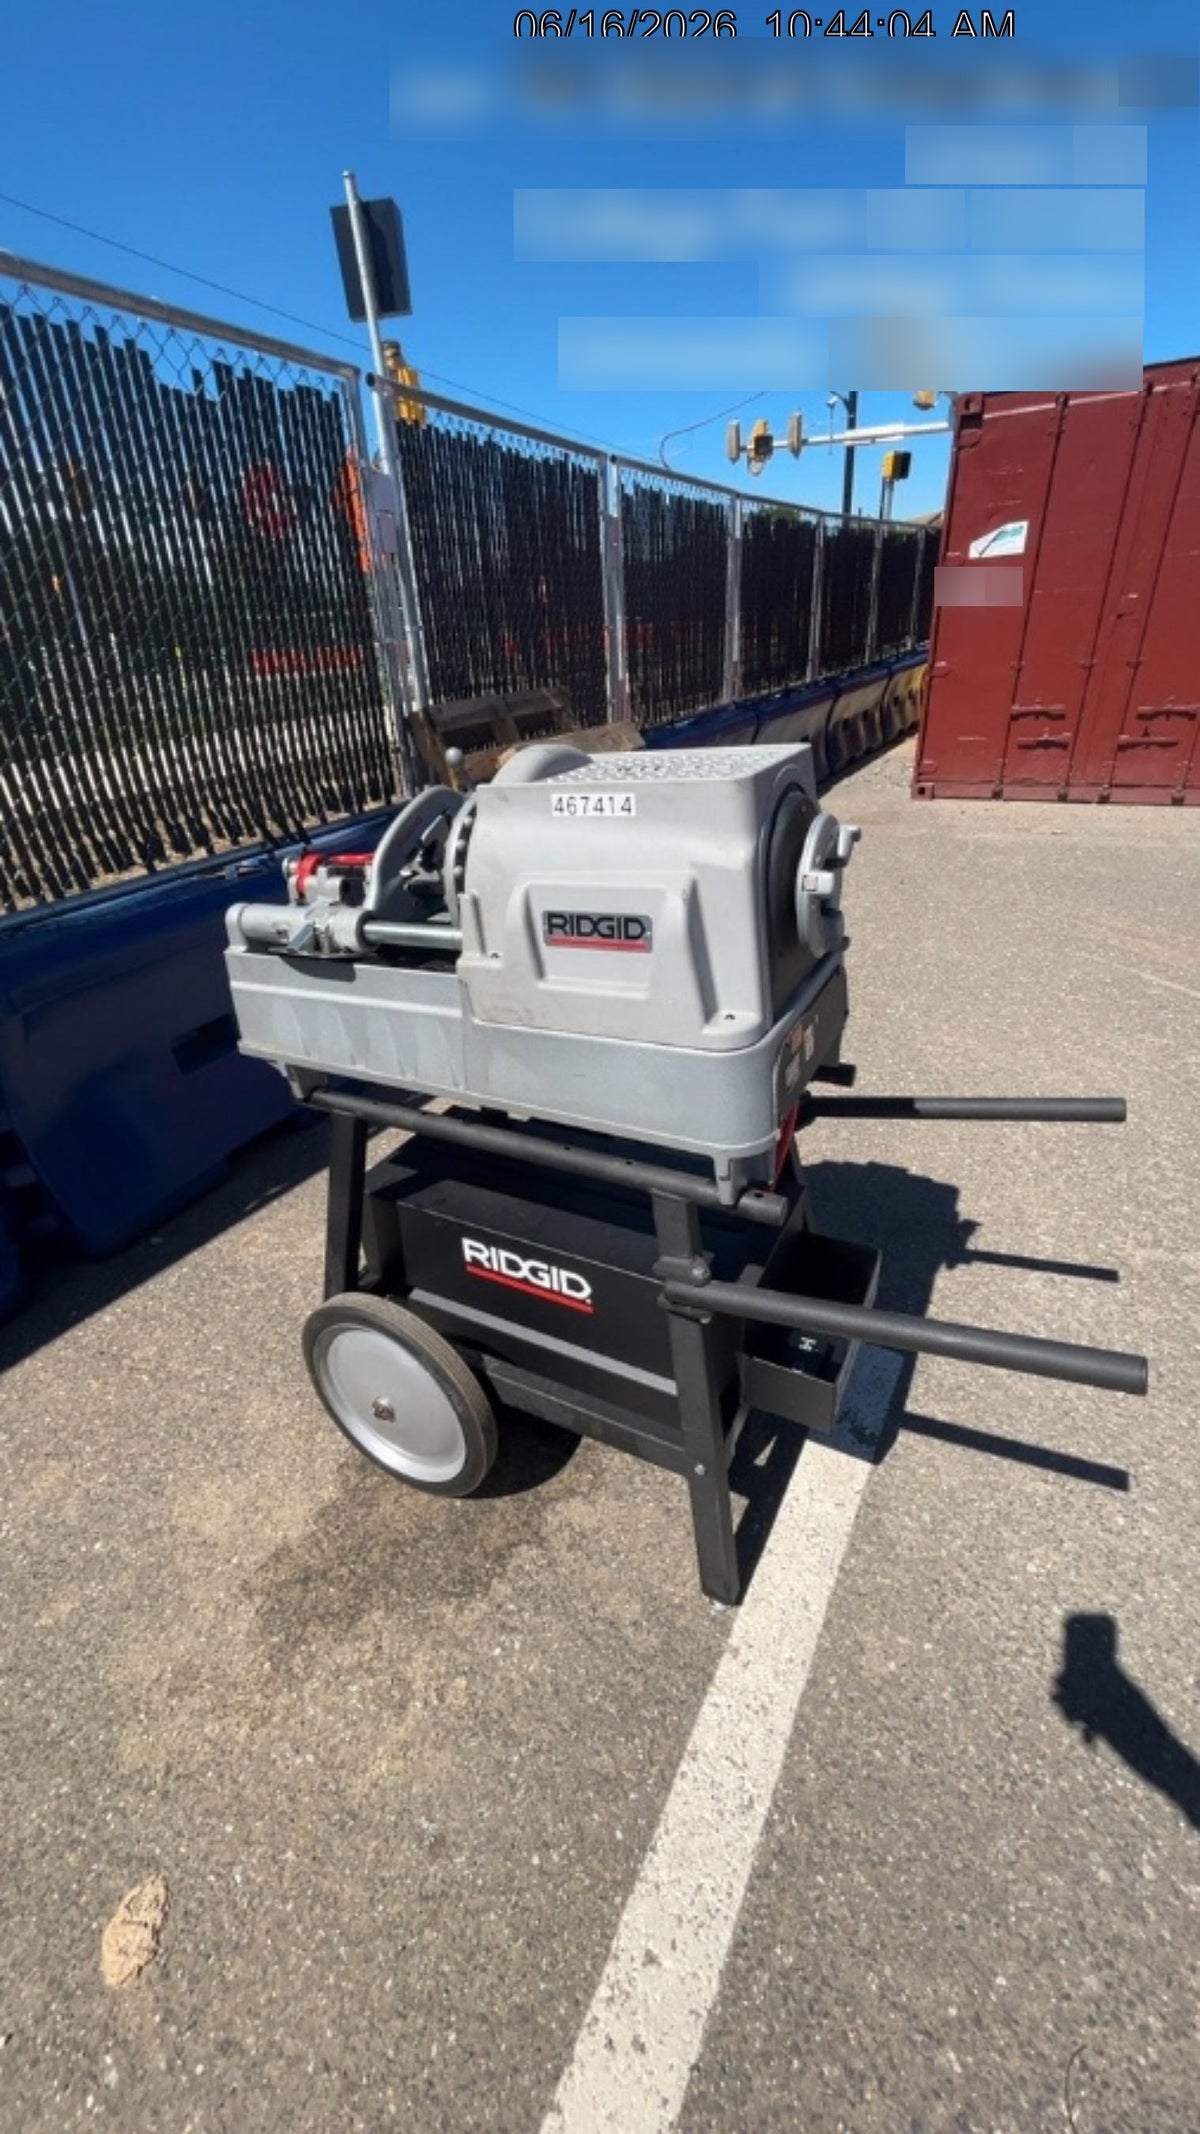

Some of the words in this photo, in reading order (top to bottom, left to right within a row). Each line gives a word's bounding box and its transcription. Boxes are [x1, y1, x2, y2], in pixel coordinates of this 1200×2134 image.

[554, 796, 632, 816] 467414
[546, 912, 646, 940] RIDGID
[461, 1237, 593, 1304] RIDGID
